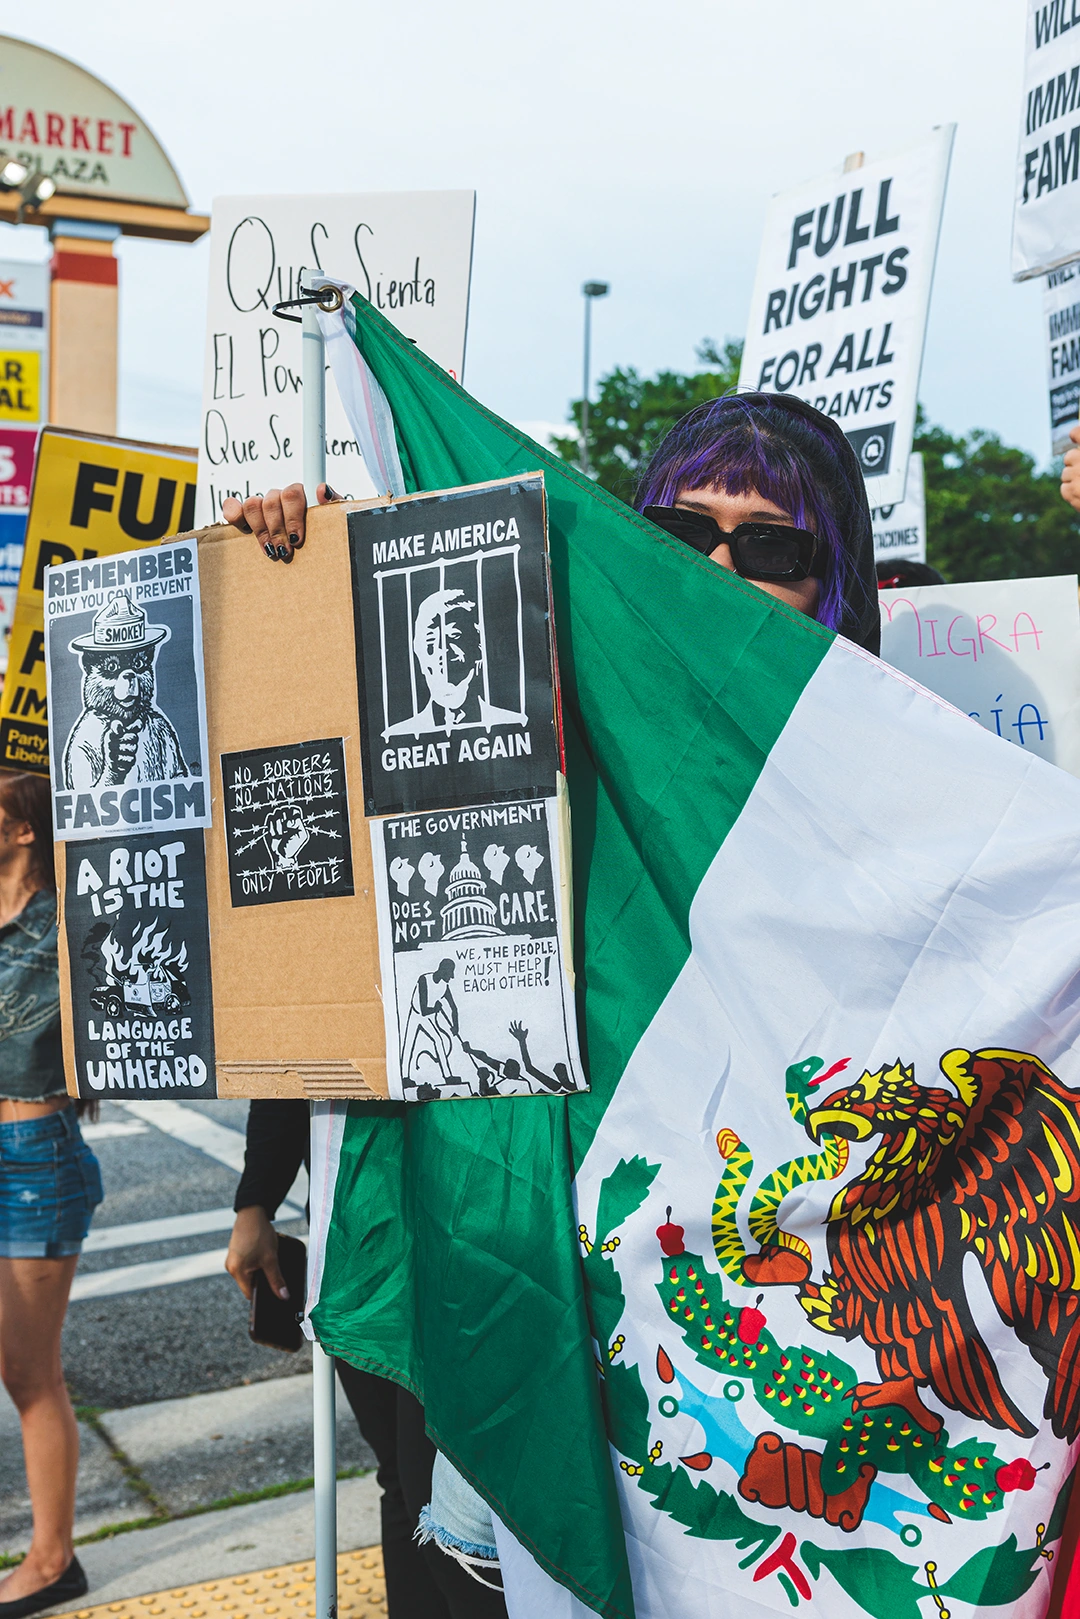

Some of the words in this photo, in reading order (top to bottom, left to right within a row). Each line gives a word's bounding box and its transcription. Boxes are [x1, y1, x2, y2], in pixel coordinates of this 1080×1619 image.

[1026, 65, 1080, 136] IMM
[786, 177, 900, 271] FULL
[354, 223, 435, 309] Sienta
[762, 246, 910, 335] RIGHTS
[758, 342, 823, 392] FOR
[825, 322, 895, 378] ALL
[805, 380, 894, 417] RANTS
[205, 409, 259, 465] Que
[269, 414, 293, 461] Se
[372, 533, 425, 565] MAKE
[431, 517, 520, 554] AMERICA
[48, 547, 193, 598] REMEMBER
[48, 597, 78, 615] ONLY
[81, 592, 104, 609] YOU
[136, 577, 192, 600] PREVENT
[105, 623, 144, 642] SMOKEY
[8, 729, 48, 751] Party
[381, 741, 450, 772] GREAT
[458, 731, 532, 763] AGAIN
[234, 766, 252, 783] NO
[263, 752, 331, 779] BORDERS
[55, 781, 206, 830] FASCISM
[235, 787, 252, 806] NO
[266, 774, 333, 800] NATIONS
[388, 822, 422, 839] THE
[425, 803, 544, 833] GOVERNMENT
[77, 858, 103, 896] A
[108, 841, 185, 887] RIOT
[242, 873, 275, 895] ONLY
[286, 865, 341, 890] PEOPLE
[90, 887, 123, 917] IS
[126, 880, 185, 909] THE
[392, 900, 432, 920] DOES
[500, 889, 555, 926] CARE.
[395, 919, 436, 943] NOT
[456, 948, 482, 960] WE,
[483, 946, 509, 959] THE
[513, 941, 557, 957] PEOPLE,
[465, 962, 502, 976] MUST
[508, 957, 542, 973] HELP
[463, 977, 496, 992] EACH
[88, 1017, 193, 1041] LANGUAGE
[105, 1042, 131, 1060] OF
[136, 1041, 175, 1057] THE
[86, 1054, 208, 1091] UNHEARD
